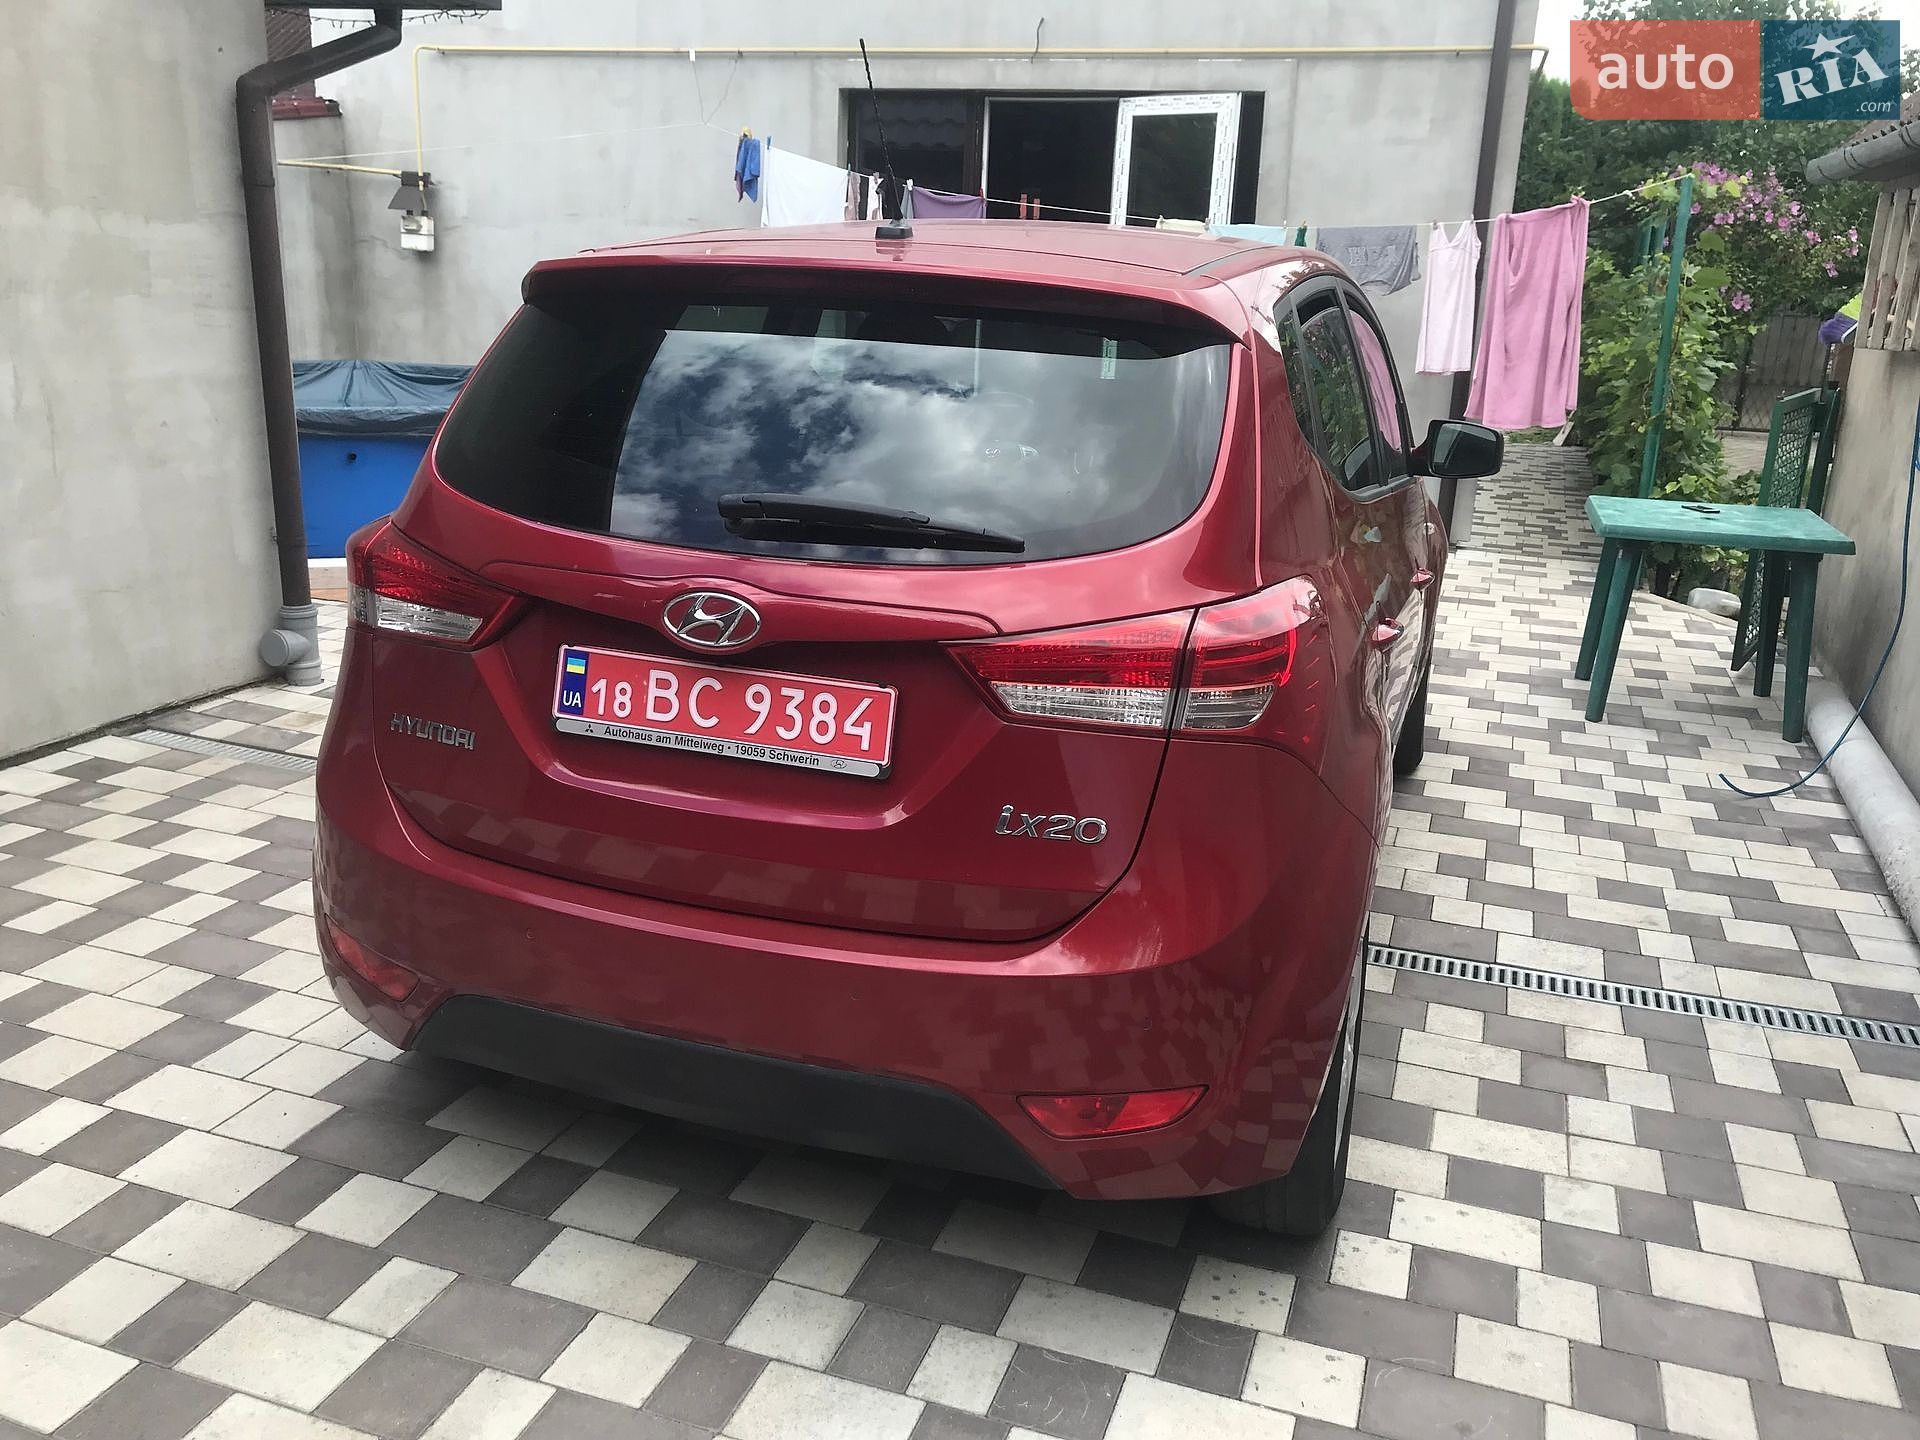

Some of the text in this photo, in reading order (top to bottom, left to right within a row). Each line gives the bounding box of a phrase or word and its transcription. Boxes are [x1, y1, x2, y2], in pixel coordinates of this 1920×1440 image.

[563, 690, 582, 707] UA
[591, 669, 874, 751] 18 BC 9384
[390, 712, 476, 751] HYUNDAI
[603, 726, 820, 766] Autohaus am Mittelweg 19059 Schwerin
[995, 804, 1108, 844] ix20
